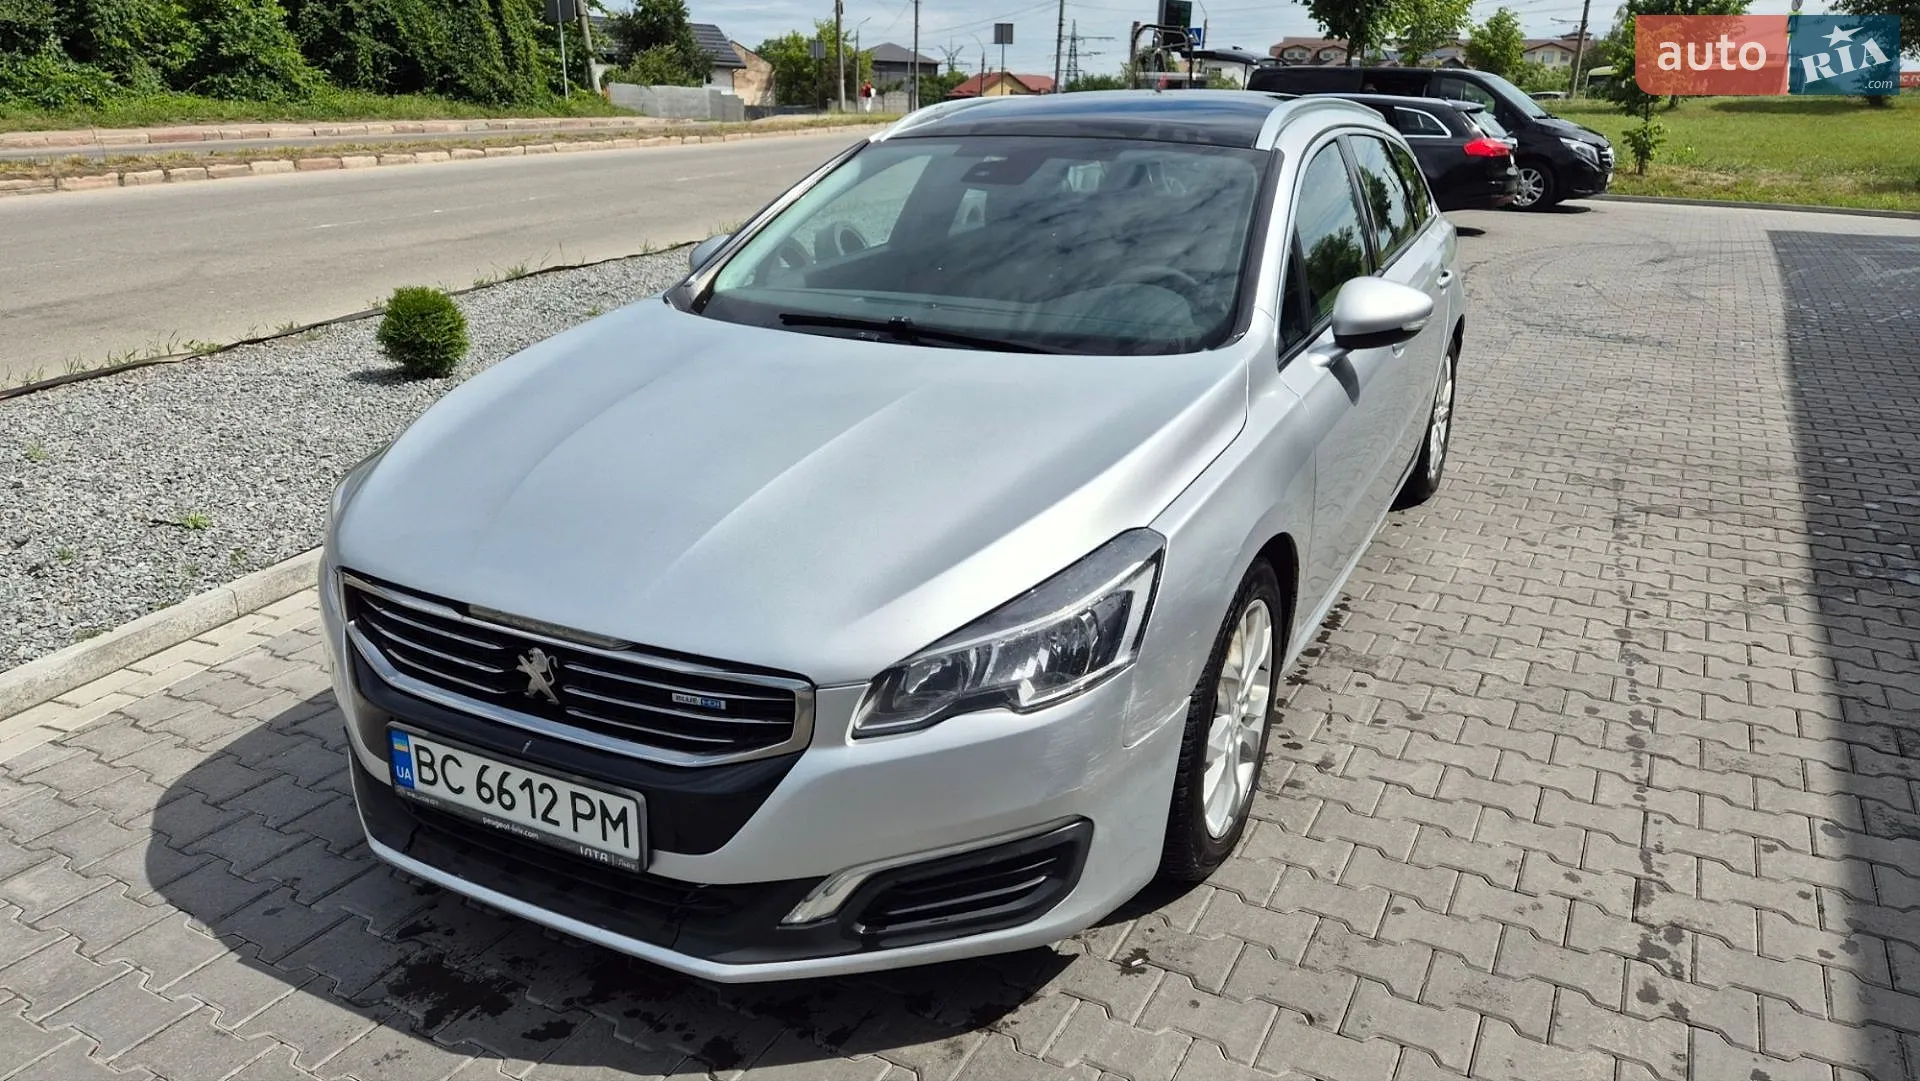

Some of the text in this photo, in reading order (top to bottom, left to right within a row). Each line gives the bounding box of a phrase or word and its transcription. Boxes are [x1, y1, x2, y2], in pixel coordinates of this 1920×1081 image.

[396, 766, 412, 780] UA
[414, 744, 630, 848] BC 6612 PM
